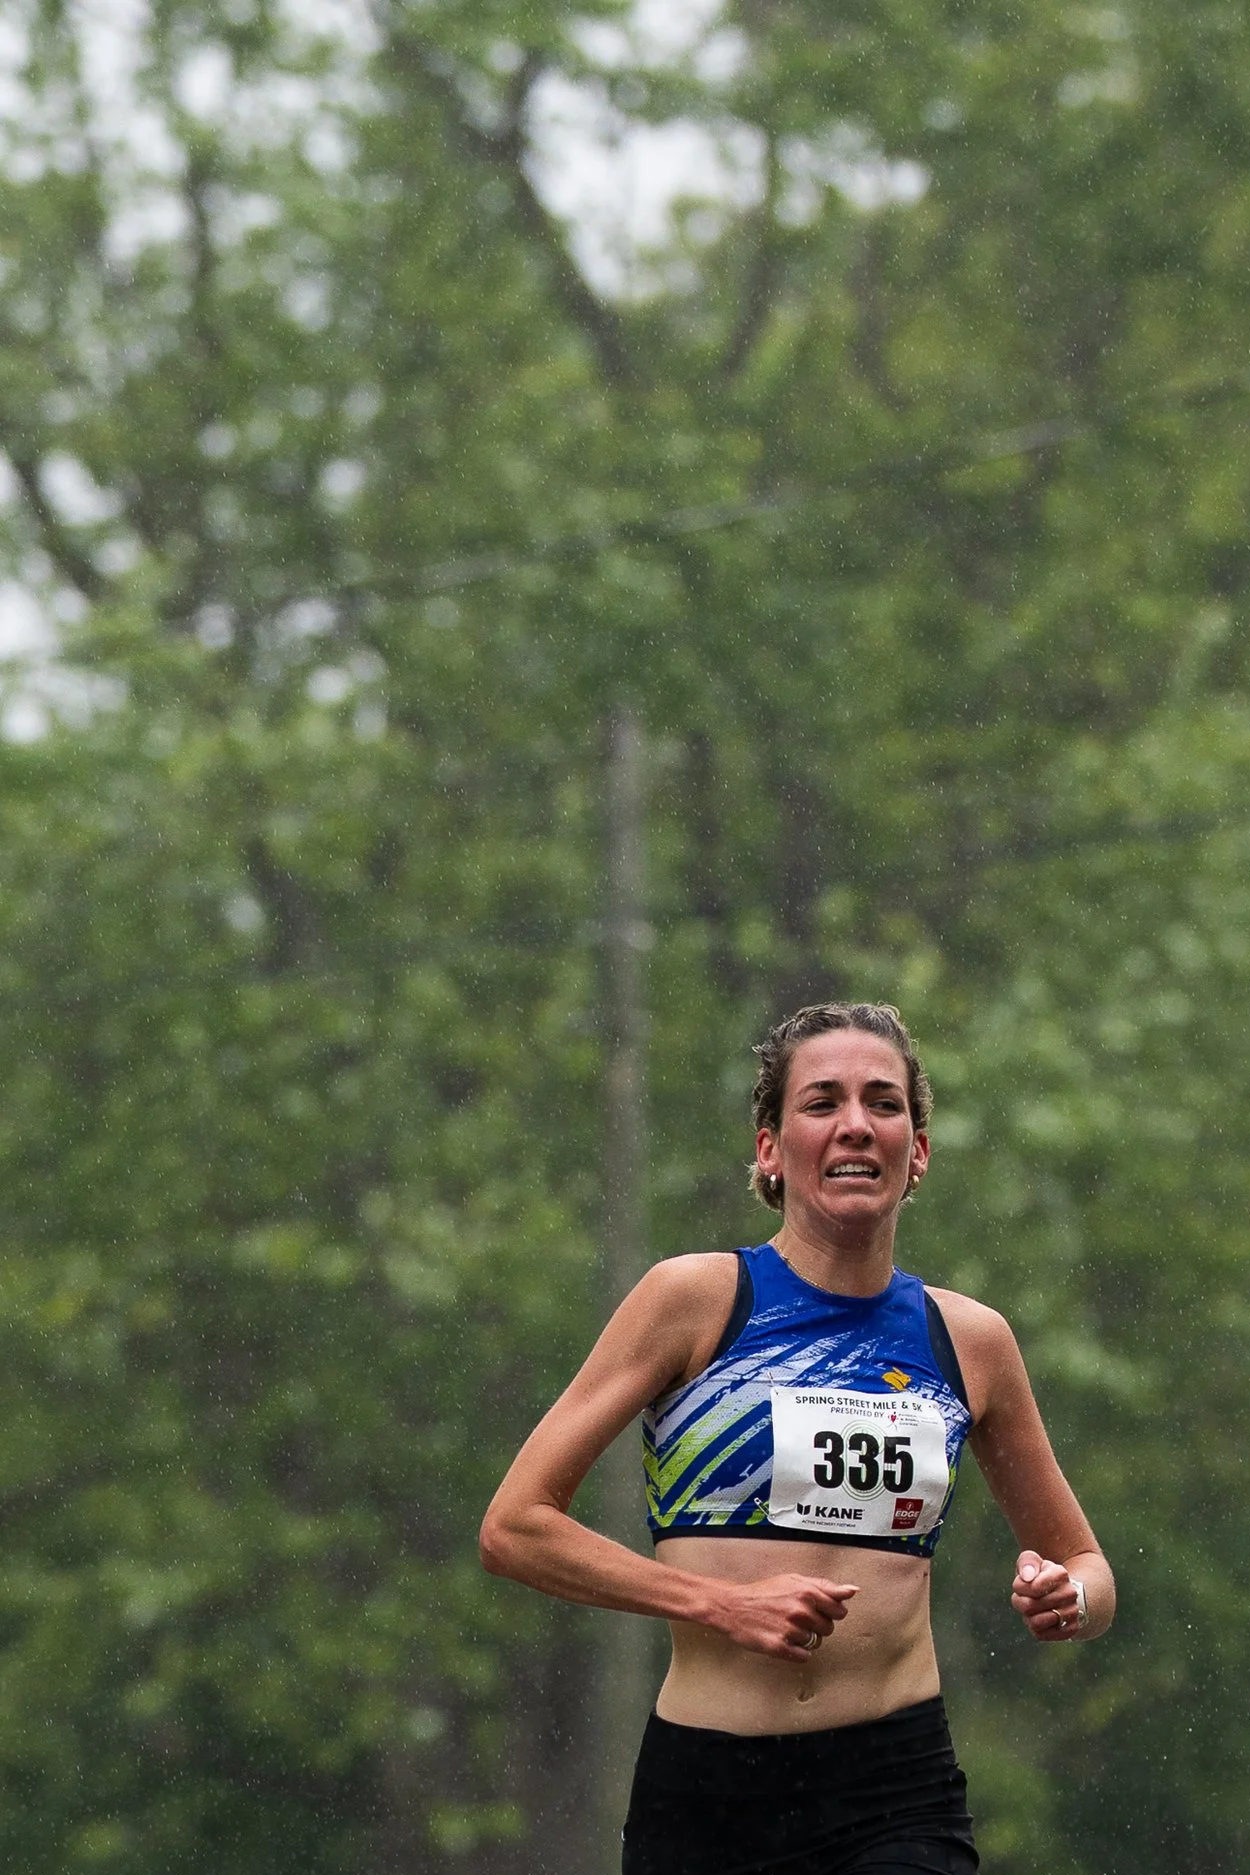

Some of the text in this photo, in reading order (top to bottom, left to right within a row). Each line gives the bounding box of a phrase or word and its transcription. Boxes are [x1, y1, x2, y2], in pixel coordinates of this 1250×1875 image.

[795, 1396, 923, 1412] SPRING STREET MILE & 5K
[830, 1406, 872, 1418] PRESENTED
[813, 1431, 914, 1494] 335
[815, 1505, 863, 1520] KANE
[895, 1510, 920, 1518] EDGE
